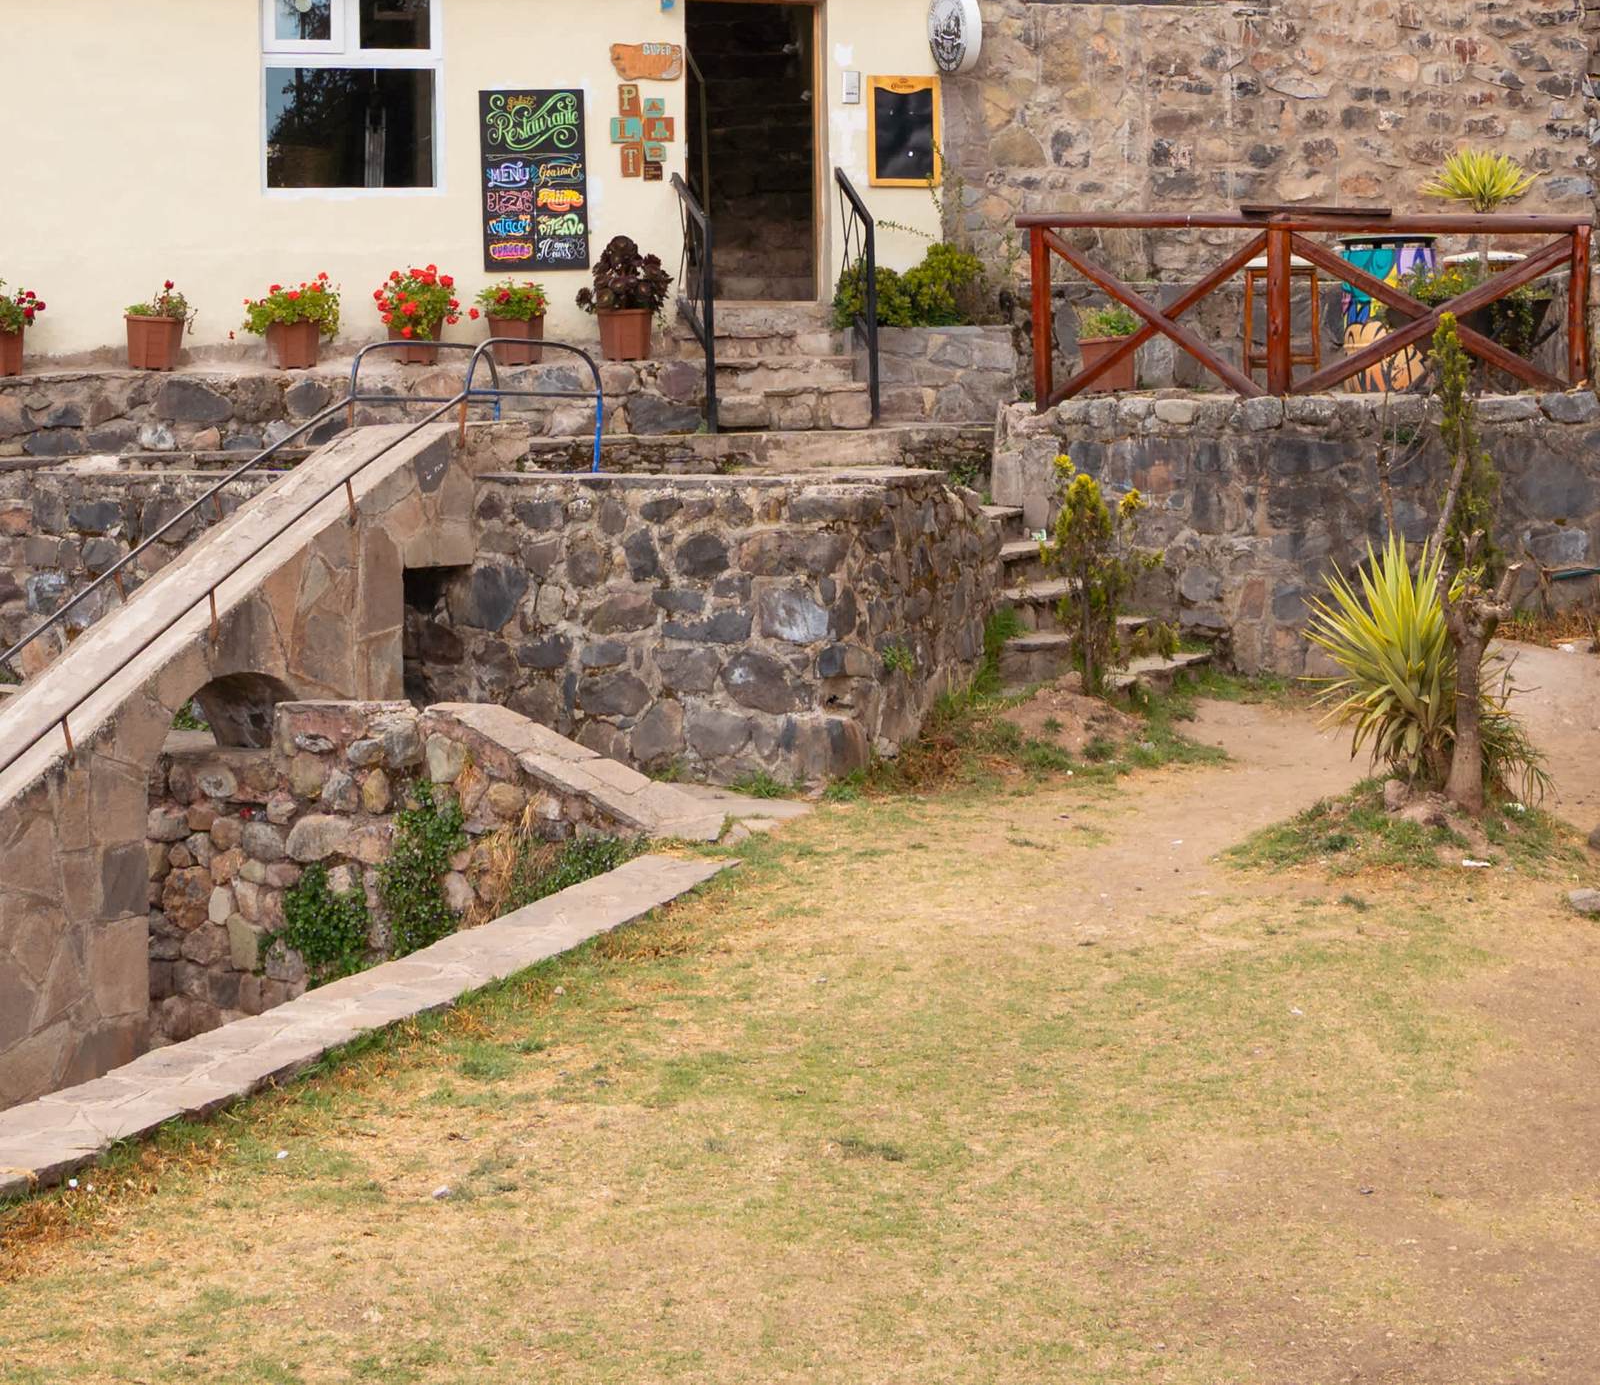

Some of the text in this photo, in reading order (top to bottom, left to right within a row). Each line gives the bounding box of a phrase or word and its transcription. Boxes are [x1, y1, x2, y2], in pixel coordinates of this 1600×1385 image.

[487, 95, 580, 146] Restaurante
[488, 163, 530, 186] MENU
[487, 190, 533, 213] PIZZAS
